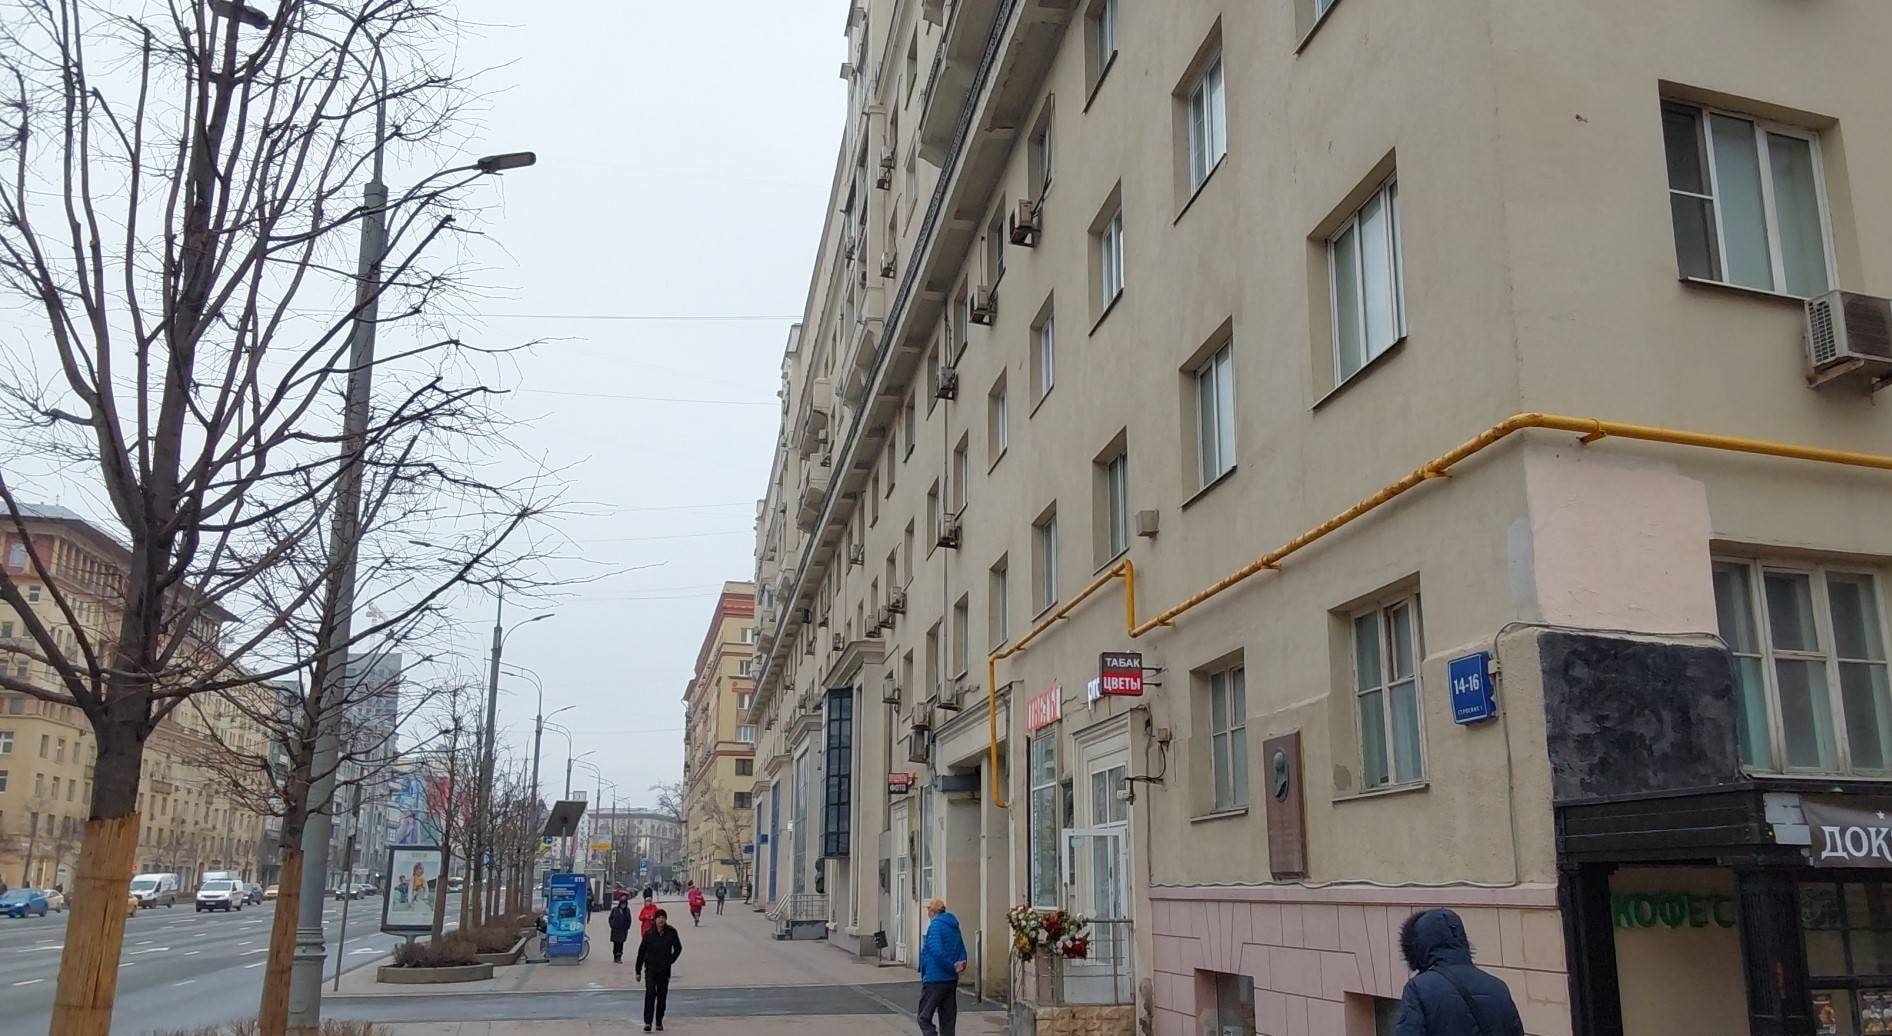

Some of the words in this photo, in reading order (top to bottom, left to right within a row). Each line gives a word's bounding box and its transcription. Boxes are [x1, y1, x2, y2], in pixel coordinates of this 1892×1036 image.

[1104, 657, 1140, 668] ТАБАК
[1103, 676, 1141, 691] ЦВЕТЫ
[1453, 673, 1480, 695] 14-16
[1820, 826, 1892, 863] ДОК
